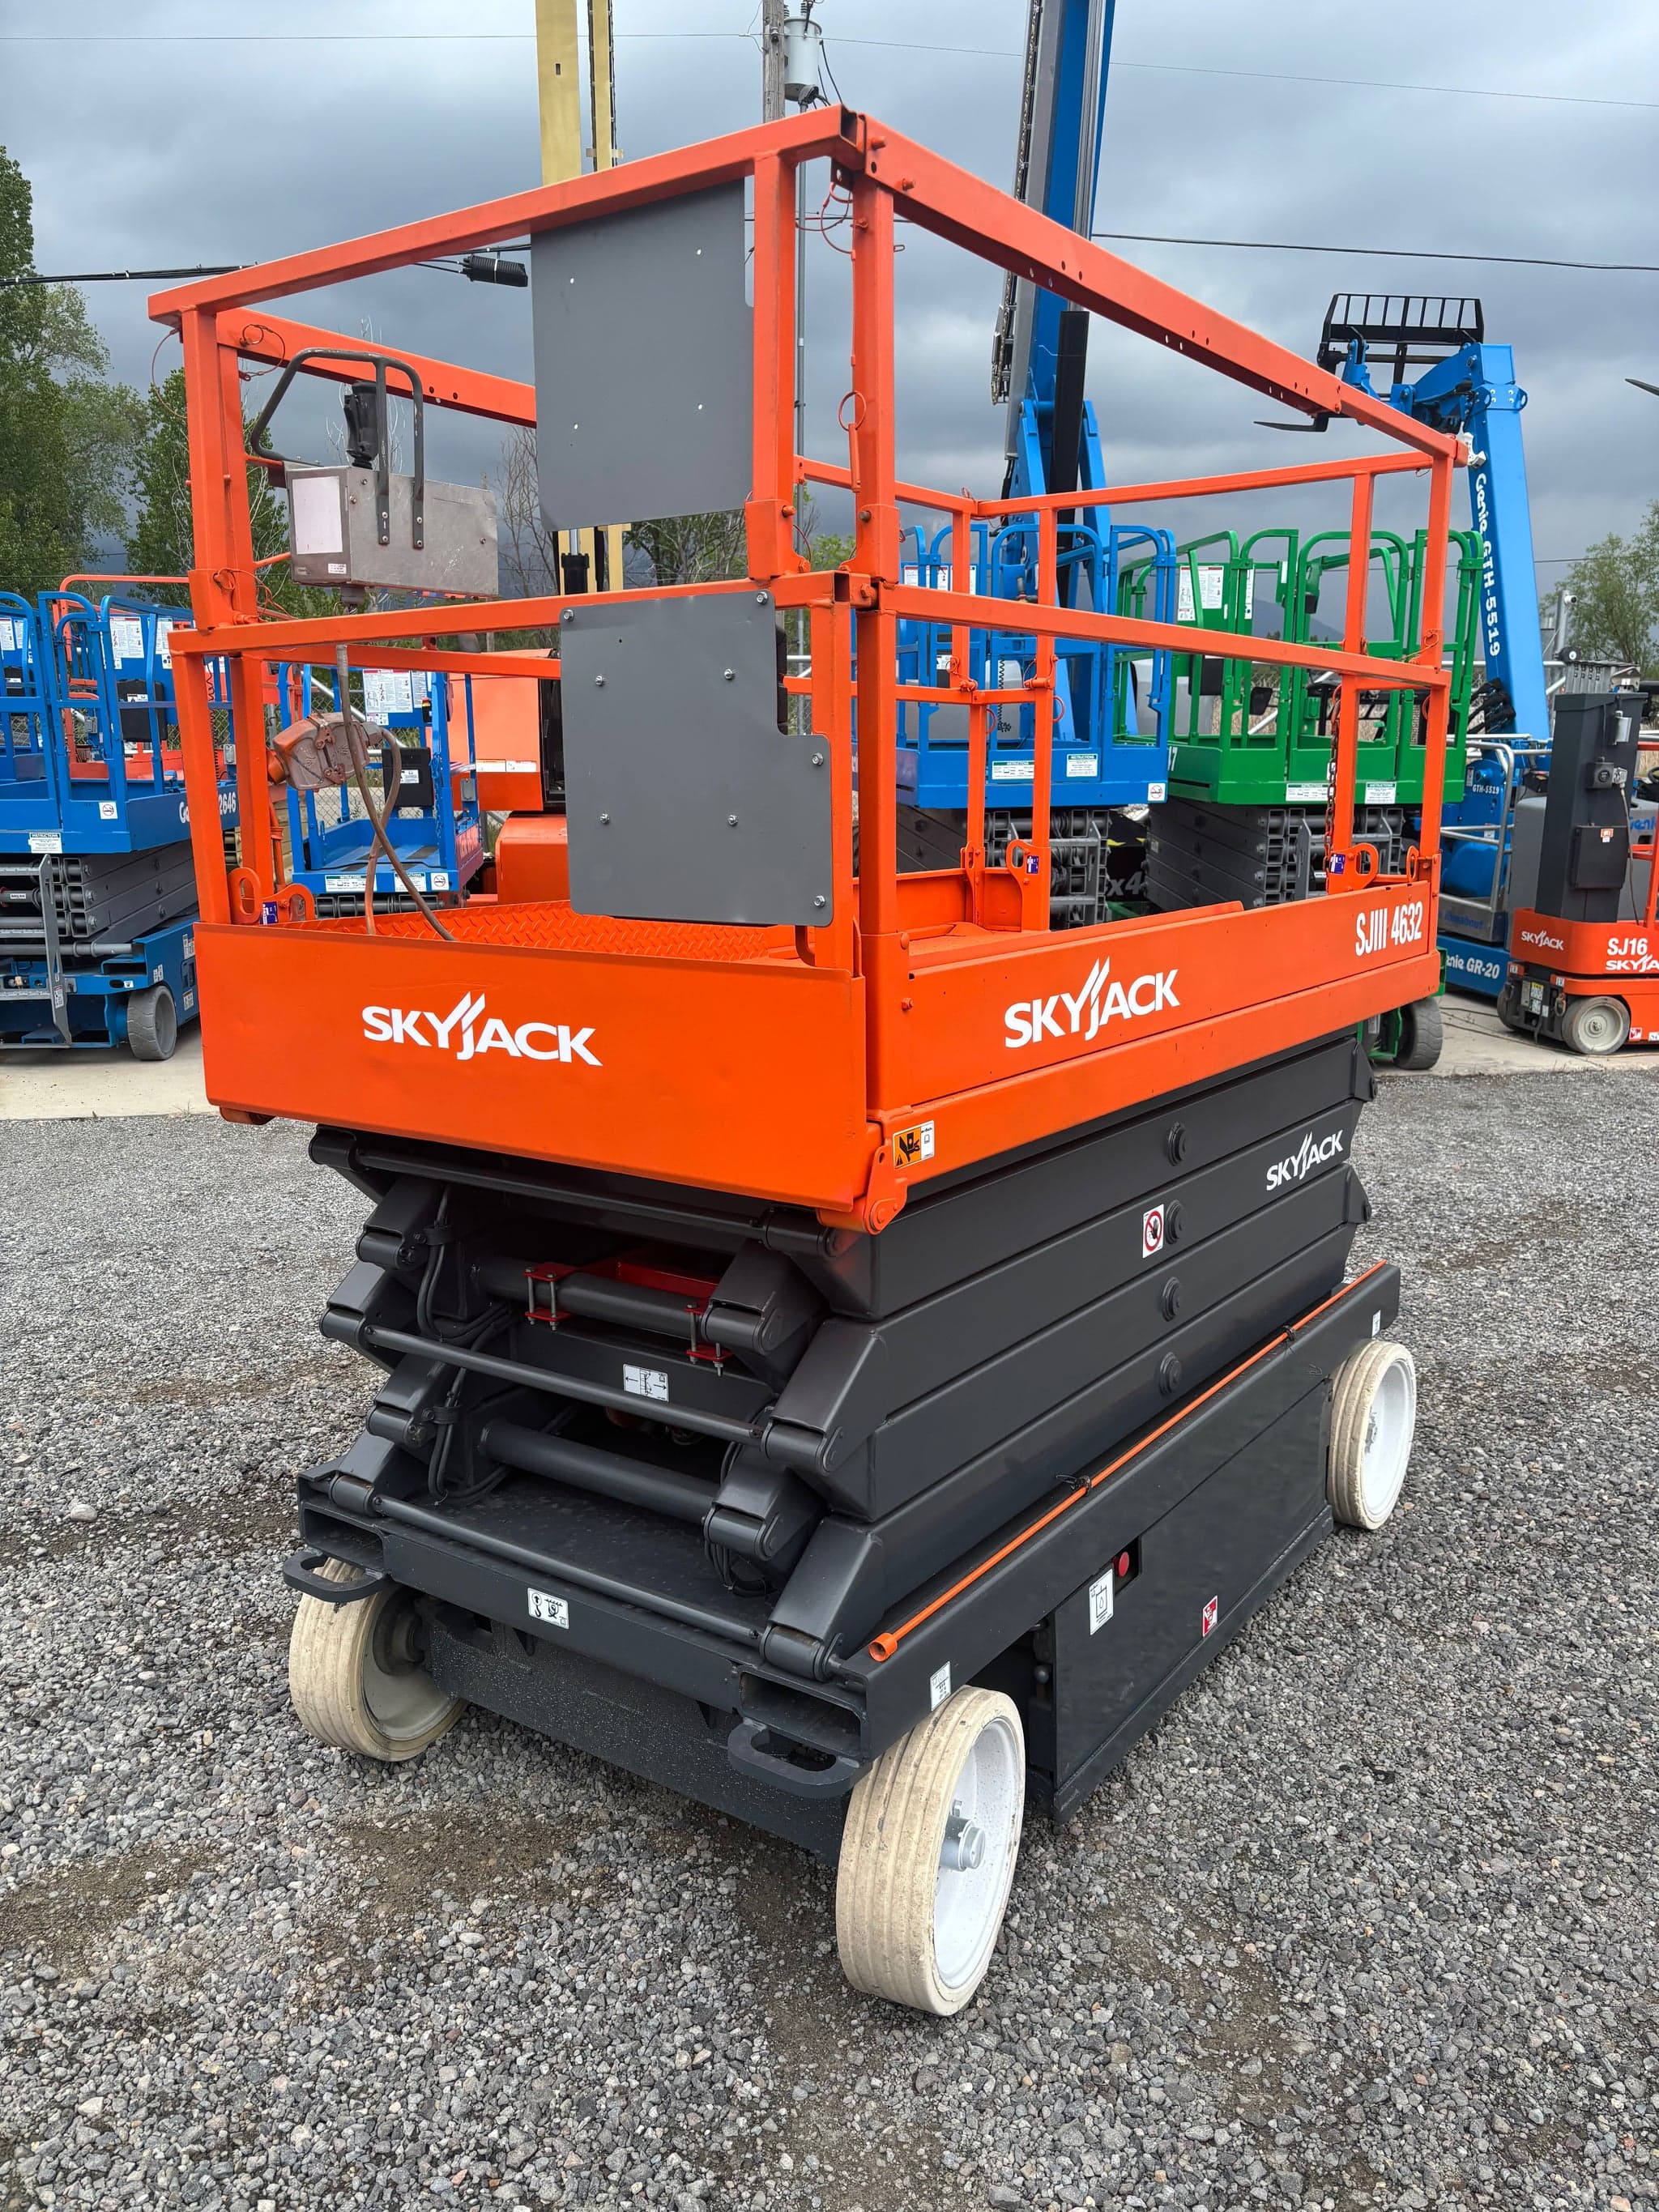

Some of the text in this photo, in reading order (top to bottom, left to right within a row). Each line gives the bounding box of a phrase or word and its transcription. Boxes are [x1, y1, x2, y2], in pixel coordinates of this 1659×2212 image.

[1476, 473, 1500, 657] Genie GTH-5519
[1472, 784, 1500, 795] GTH-5519
[218, 791, 237, 816] 2646
[1105, 871, 1143, 897] x4
[1391, 901, 1423, 946] 4632
[1521, 930, 1565, 951] SKYJACK
[1607, 938, 1648, 956] SJ16
[1446, 954, 1500, 979] enie GR-20
[1606, 953, 1659, 972] SKYJA
[1004, 955, 1181, 1049] SKYJACK
[362, 991, 603, 1067] SKYJACK
[1265, 1129, 1345, 1191] SKYJACK
